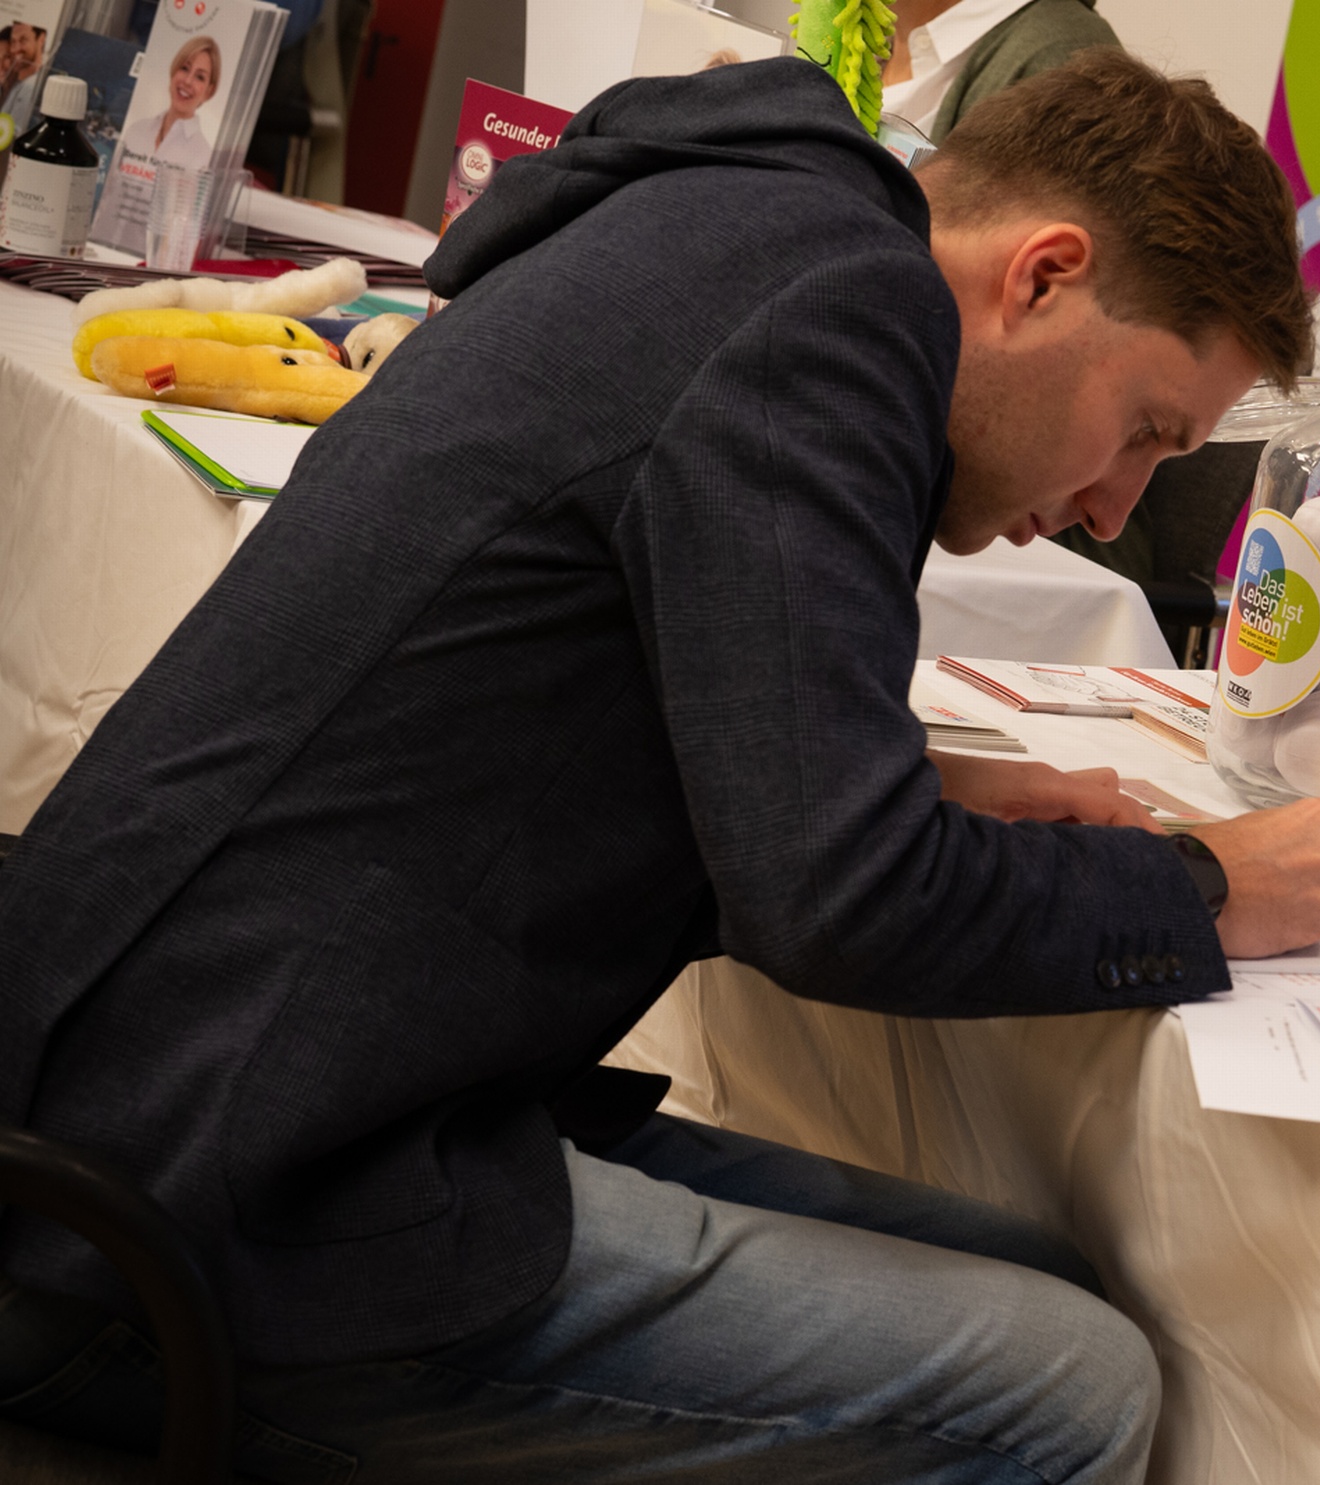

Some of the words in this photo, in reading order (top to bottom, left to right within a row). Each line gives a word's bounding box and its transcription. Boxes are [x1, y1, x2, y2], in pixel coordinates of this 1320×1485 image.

[483, 112, 552, 149] Gesunder
[1259, 568, 1286, 598] Das
[1241, 578, 1279, 615] Leben
[1281, 598, 1304, 624] ist
[1241, 607, 1290, 641] schön!
